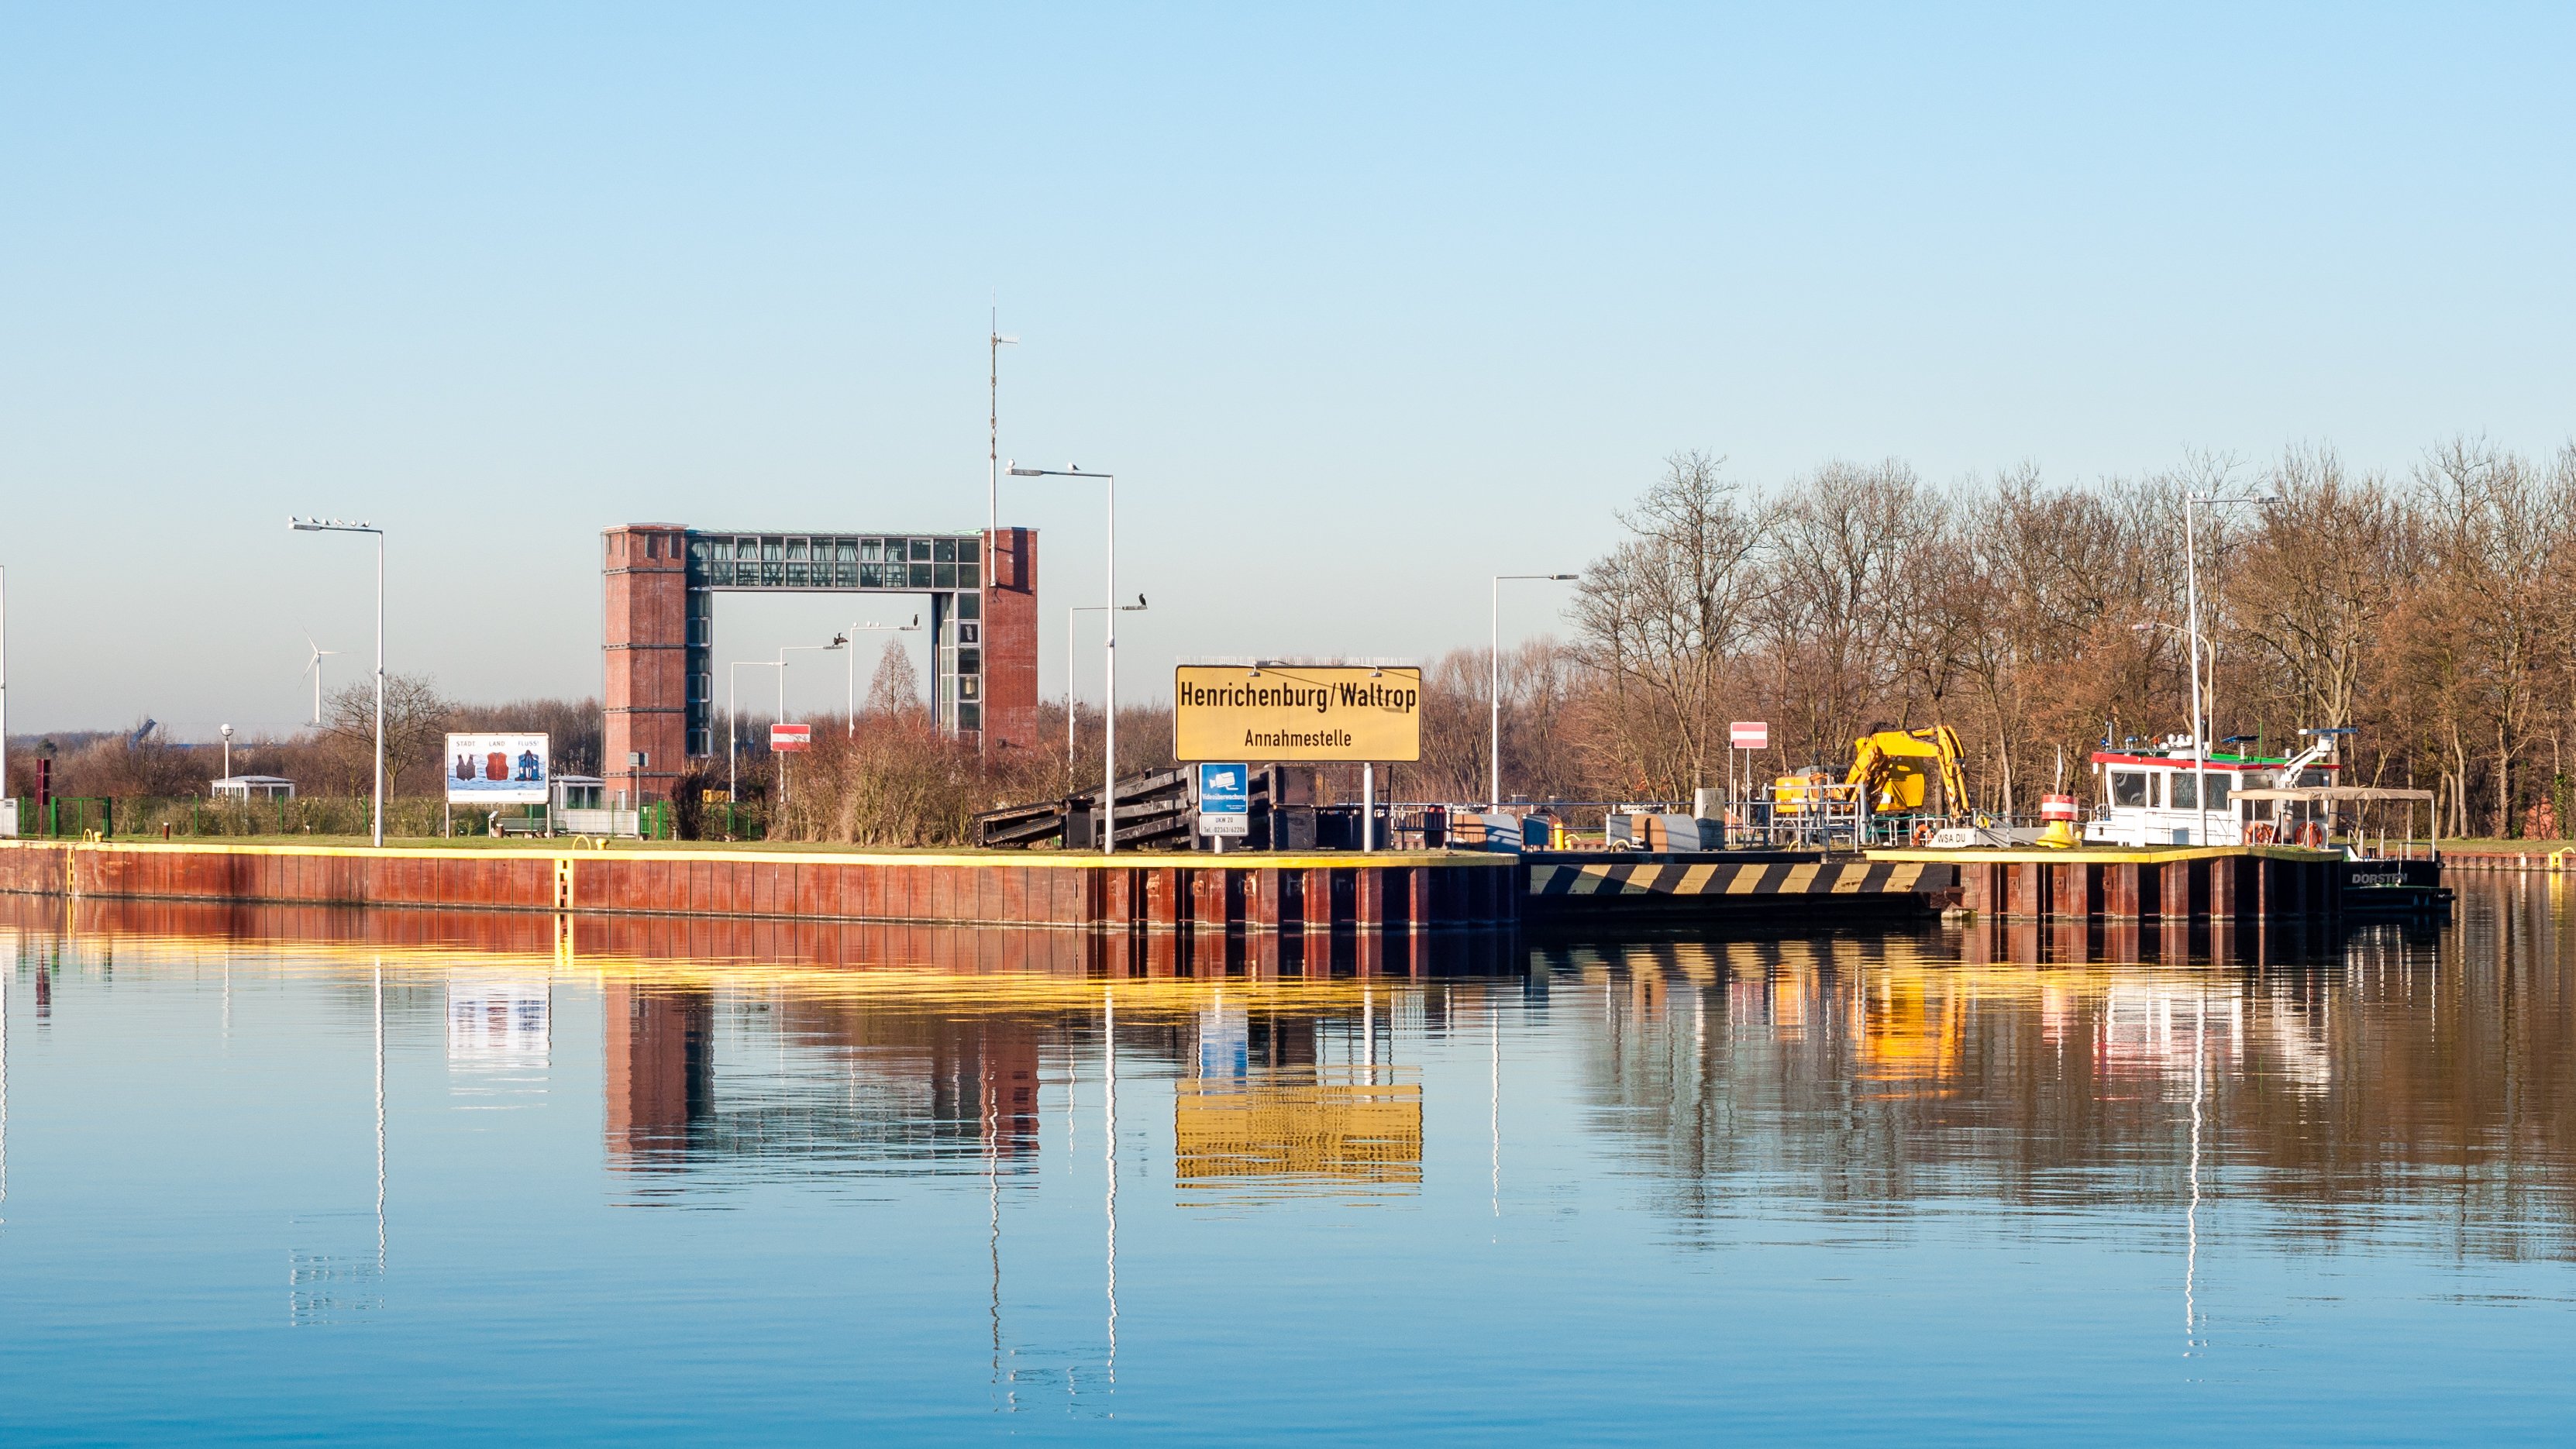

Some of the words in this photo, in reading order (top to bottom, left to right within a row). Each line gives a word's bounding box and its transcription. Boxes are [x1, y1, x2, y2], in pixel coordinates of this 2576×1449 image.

[1180, 682, 1417, 713] Henrichenburg/Waltrop
[1245, 729, 1352, 747] Annahmestelle
[1937, 834, 1954, 843] WSA
[1956, 834, 1965, 842] DU
[2352, 872, 2408, 884] DORSTEN
